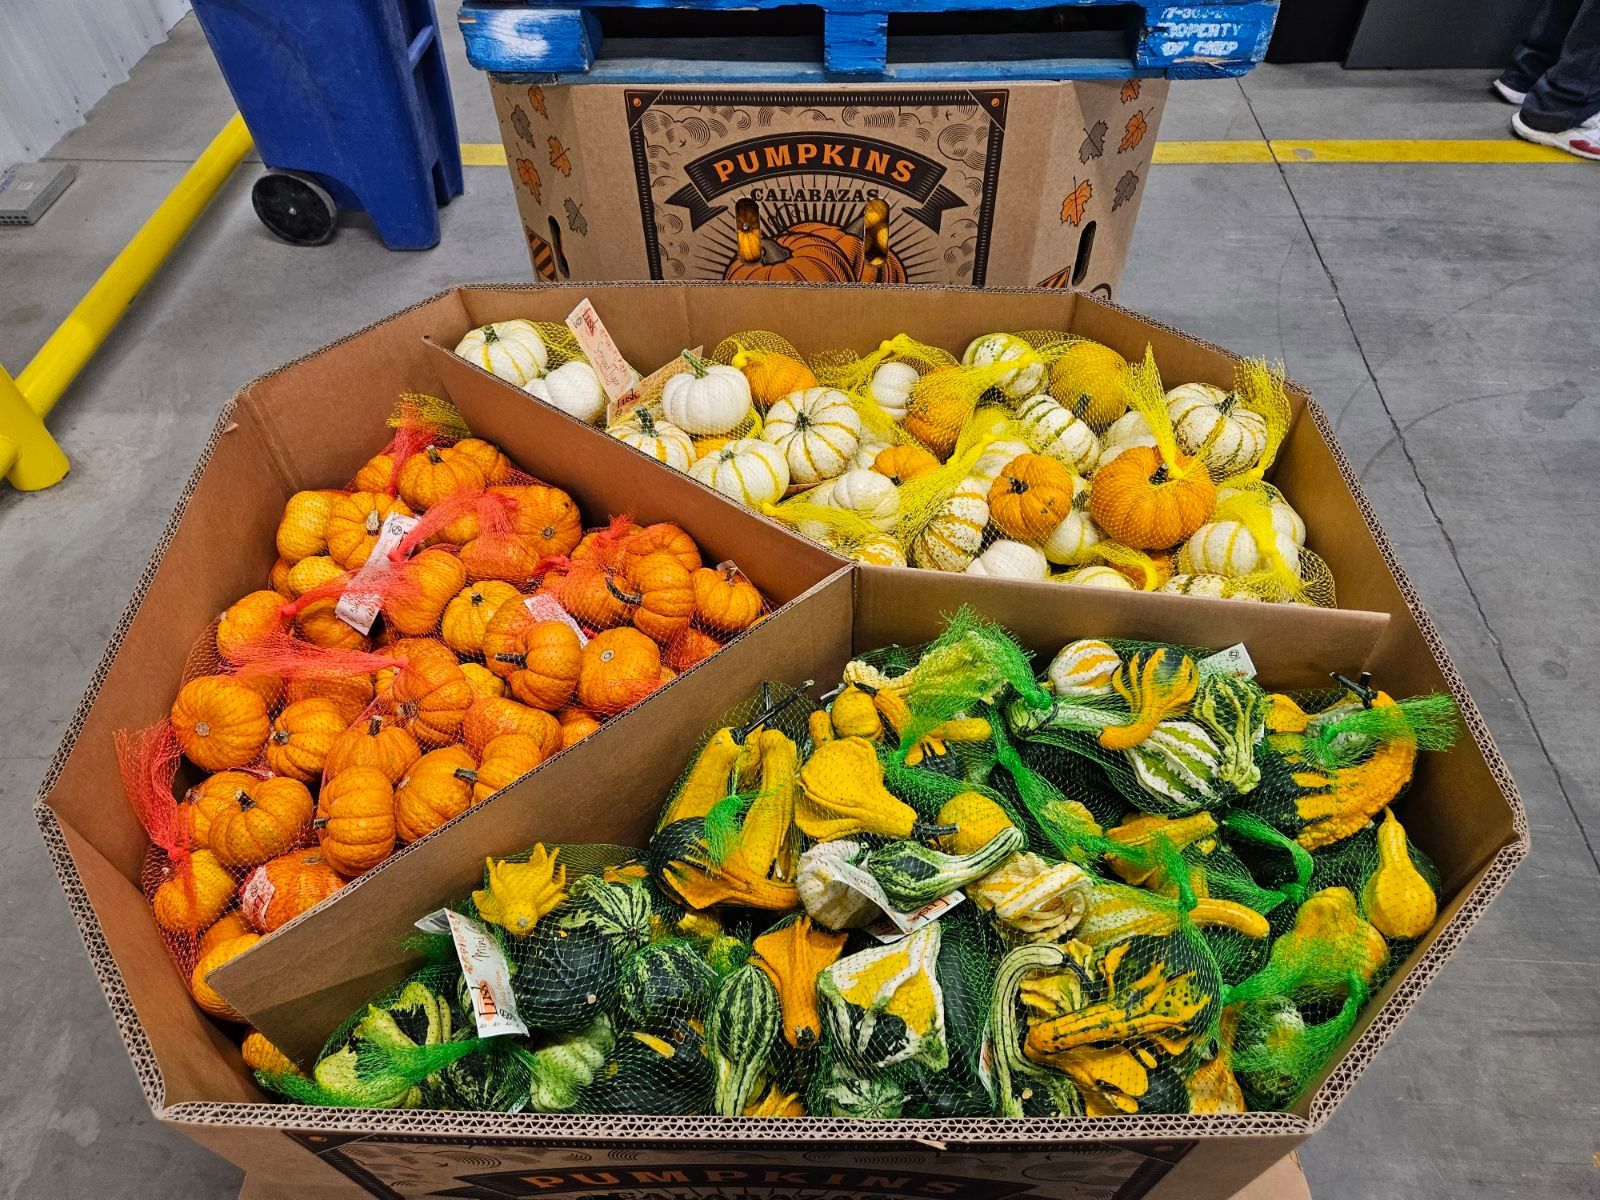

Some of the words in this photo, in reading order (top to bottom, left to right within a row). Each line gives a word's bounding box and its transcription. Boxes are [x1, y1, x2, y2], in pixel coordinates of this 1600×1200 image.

[712, 143, 916, 183] PUMPKINS
[750, 188, 880, 202] CALABAZAS
[520, 1170, 966, 1194] PUMPKINS
